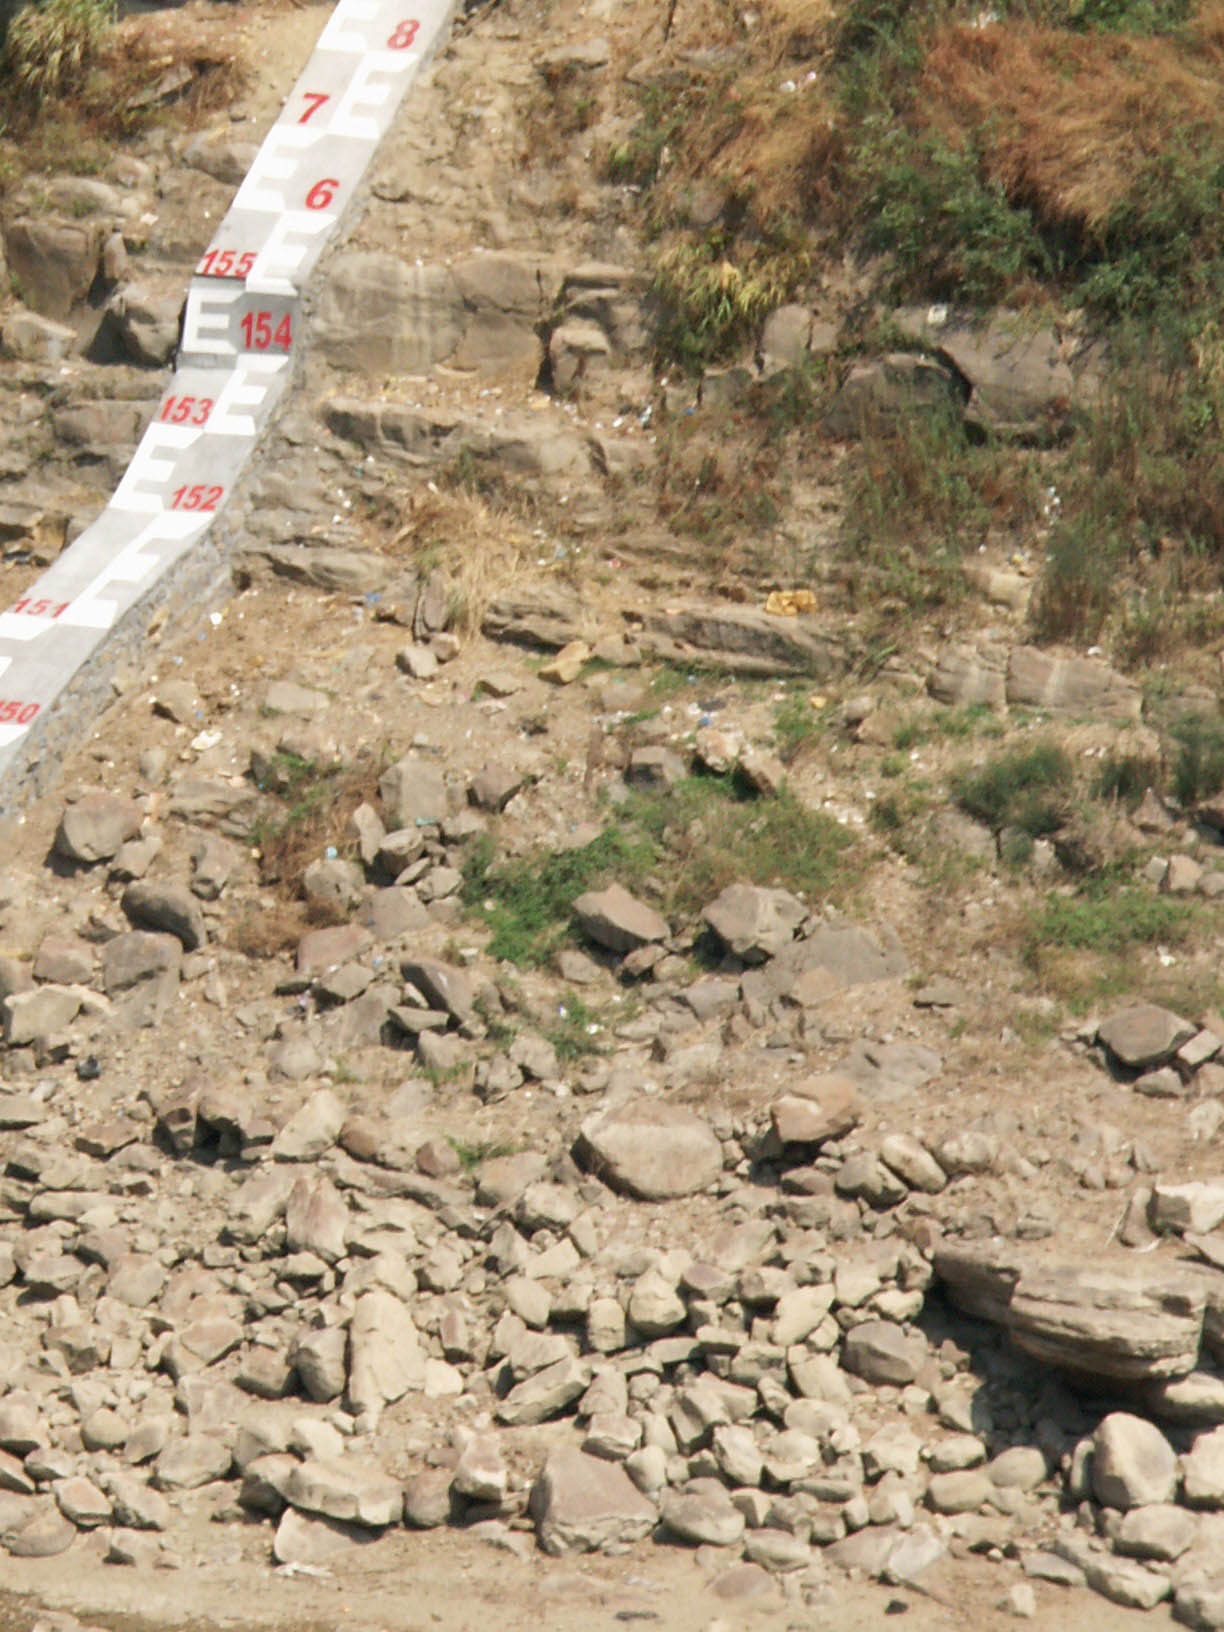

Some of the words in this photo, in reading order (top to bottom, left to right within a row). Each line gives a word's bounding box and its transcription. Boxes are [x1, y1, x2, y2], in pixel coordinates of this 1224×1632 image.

[387, 19, 421, 50] 8
[297, 92, 331, 125] 7
[304, 178, 341, 211] 6
[200, 249, 258, 280] 155
[239, 310, 294, 353] 154
[159, 394, 216, 427] 153
[170, 484, 226, 513] 152
[14, 597, 72, 619] 151
